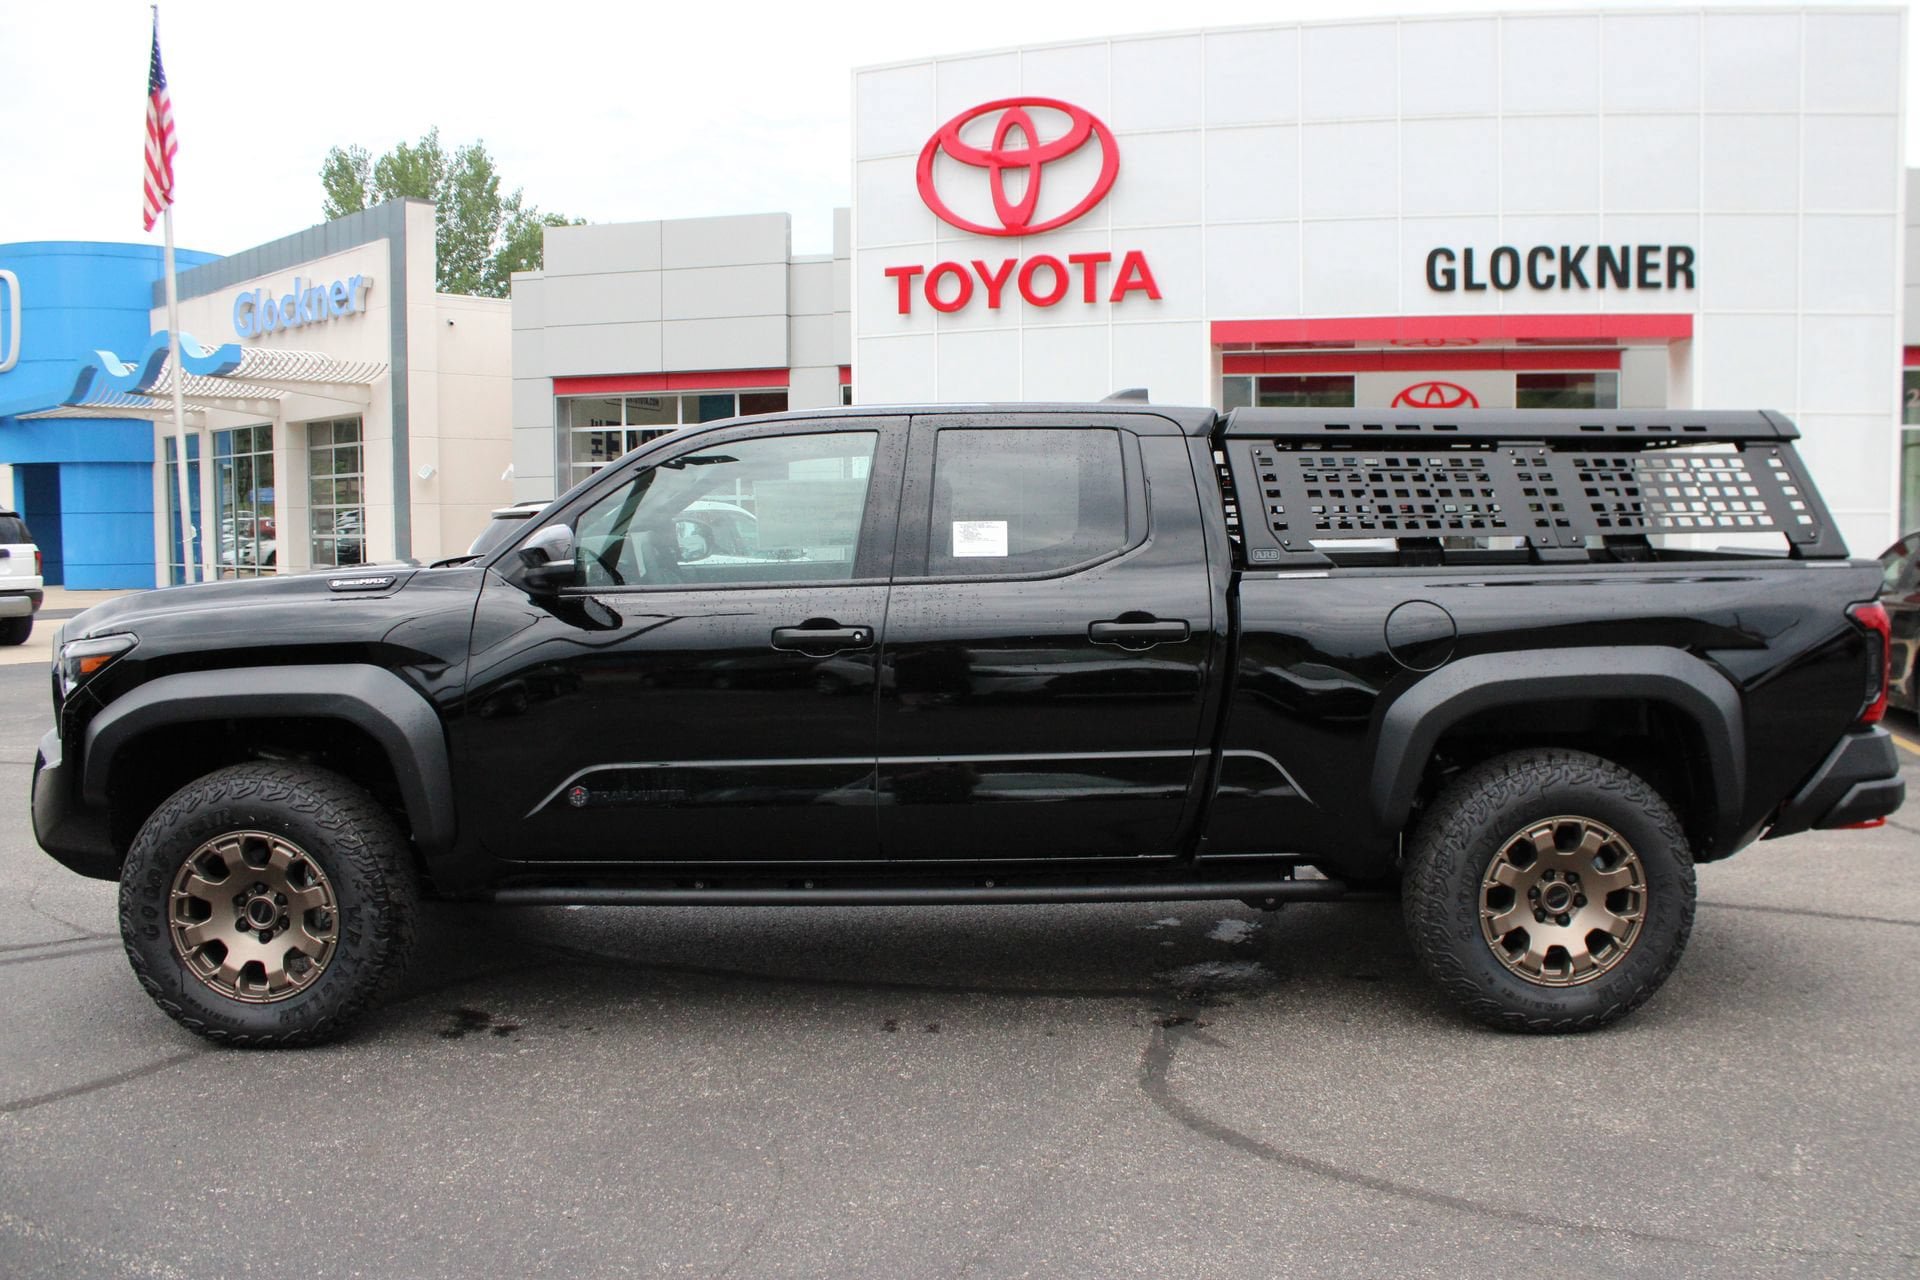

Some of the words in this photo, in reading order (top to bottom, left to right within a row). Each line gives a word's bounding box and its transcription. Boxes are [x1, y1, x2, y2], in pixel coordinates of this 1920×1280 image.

[885, 250, 1161, 315] TOYOTA
[1426, 245, 1696, 292] GLOCKNER
[233, 274, 372, 338] Glockner
[1256, 551, 1277, 559] ARB
[591, 789, 686, 802] TRAILHUNTER
